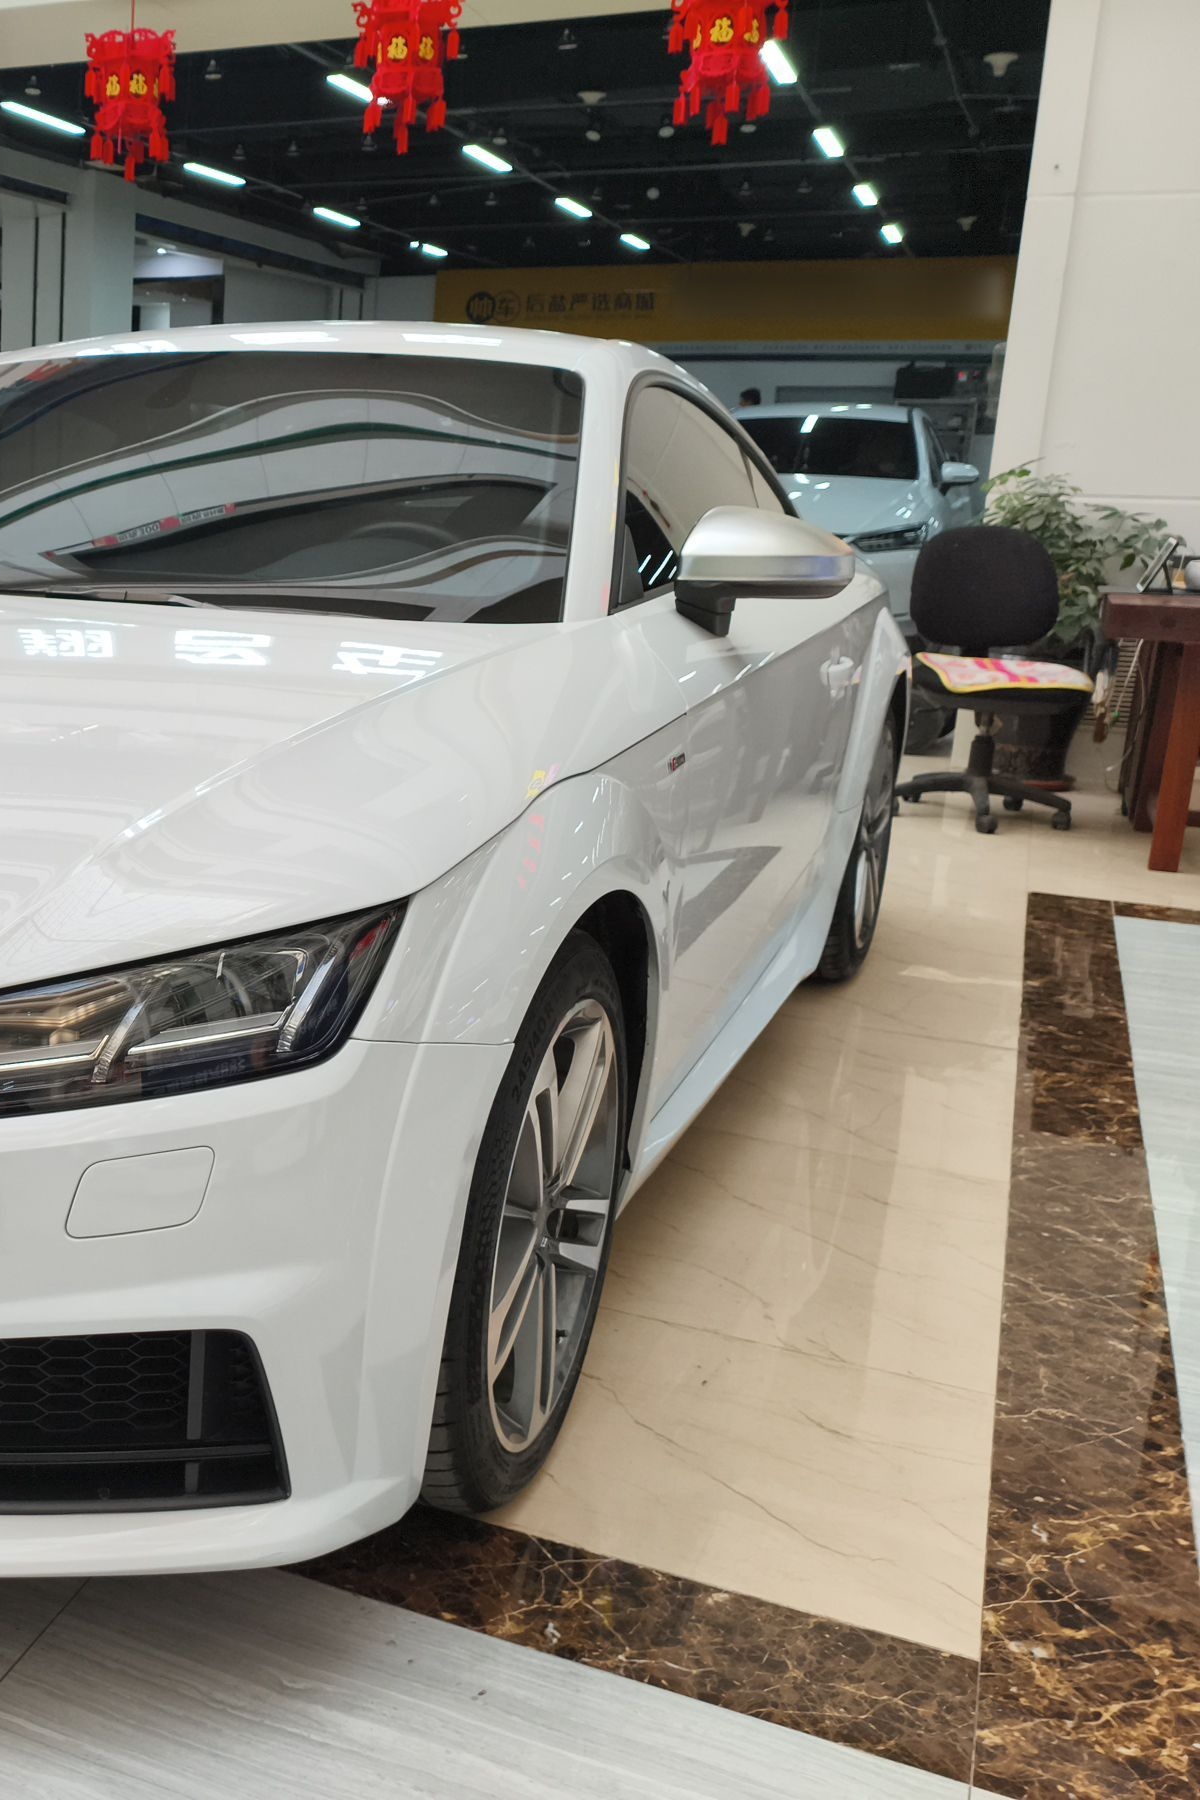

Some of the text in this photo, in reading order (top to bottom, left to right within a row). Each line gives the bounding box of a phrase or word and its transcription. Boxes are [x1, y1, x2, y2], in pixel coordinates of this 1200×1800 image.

[709, 16, 734, 43] 福
[387, 35, 408, 60] 福
[129, 73, 148, 96] 福
